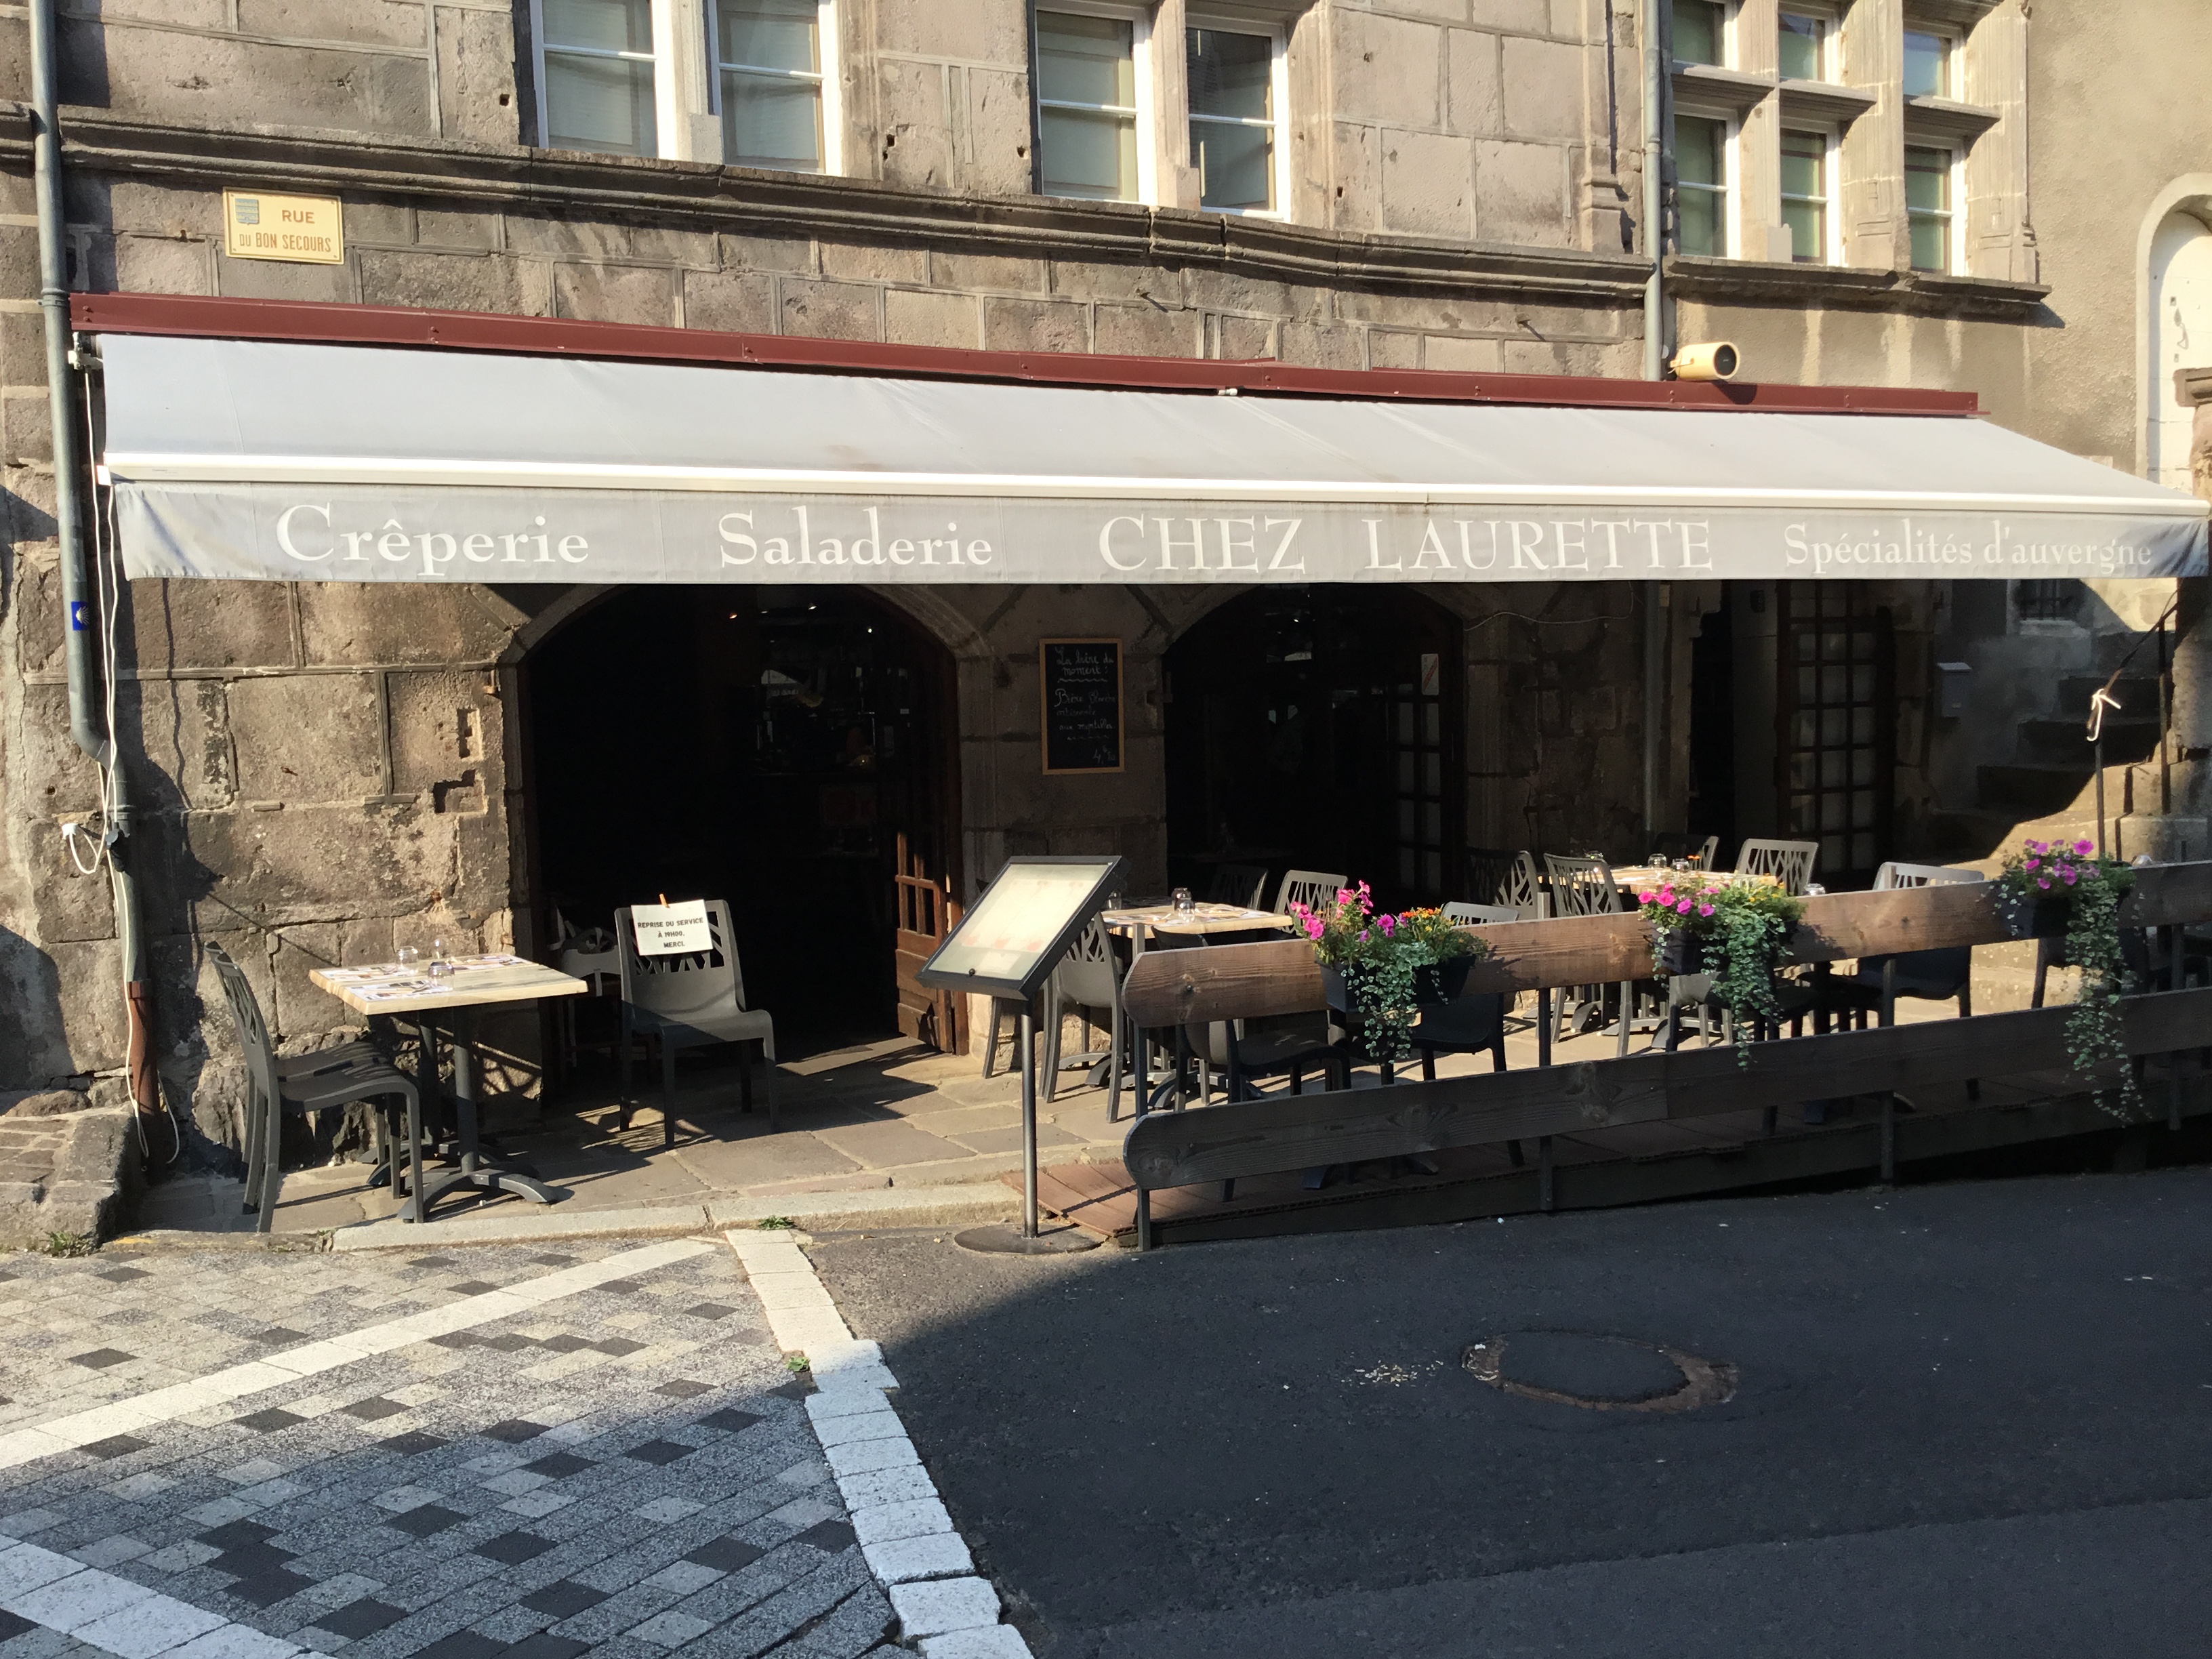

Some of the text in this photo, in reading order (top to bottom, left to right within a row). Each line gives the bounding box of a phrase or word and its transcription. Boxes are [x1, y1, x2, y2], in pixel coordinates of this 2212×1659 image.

[239, 232, 331, 253] DU BON SECOURS
[282, 209, 315, 224] RUE
[276, 502, 589, 577] Crêperie
[718, 505, 992, 568] Saladerie
[1099, 514, 1713, 575] CHEZ LAURETTE
[1783, 518, 2152, 574] Spécialités d'auvergne
[676, 917, 703, 926] SERVICE
